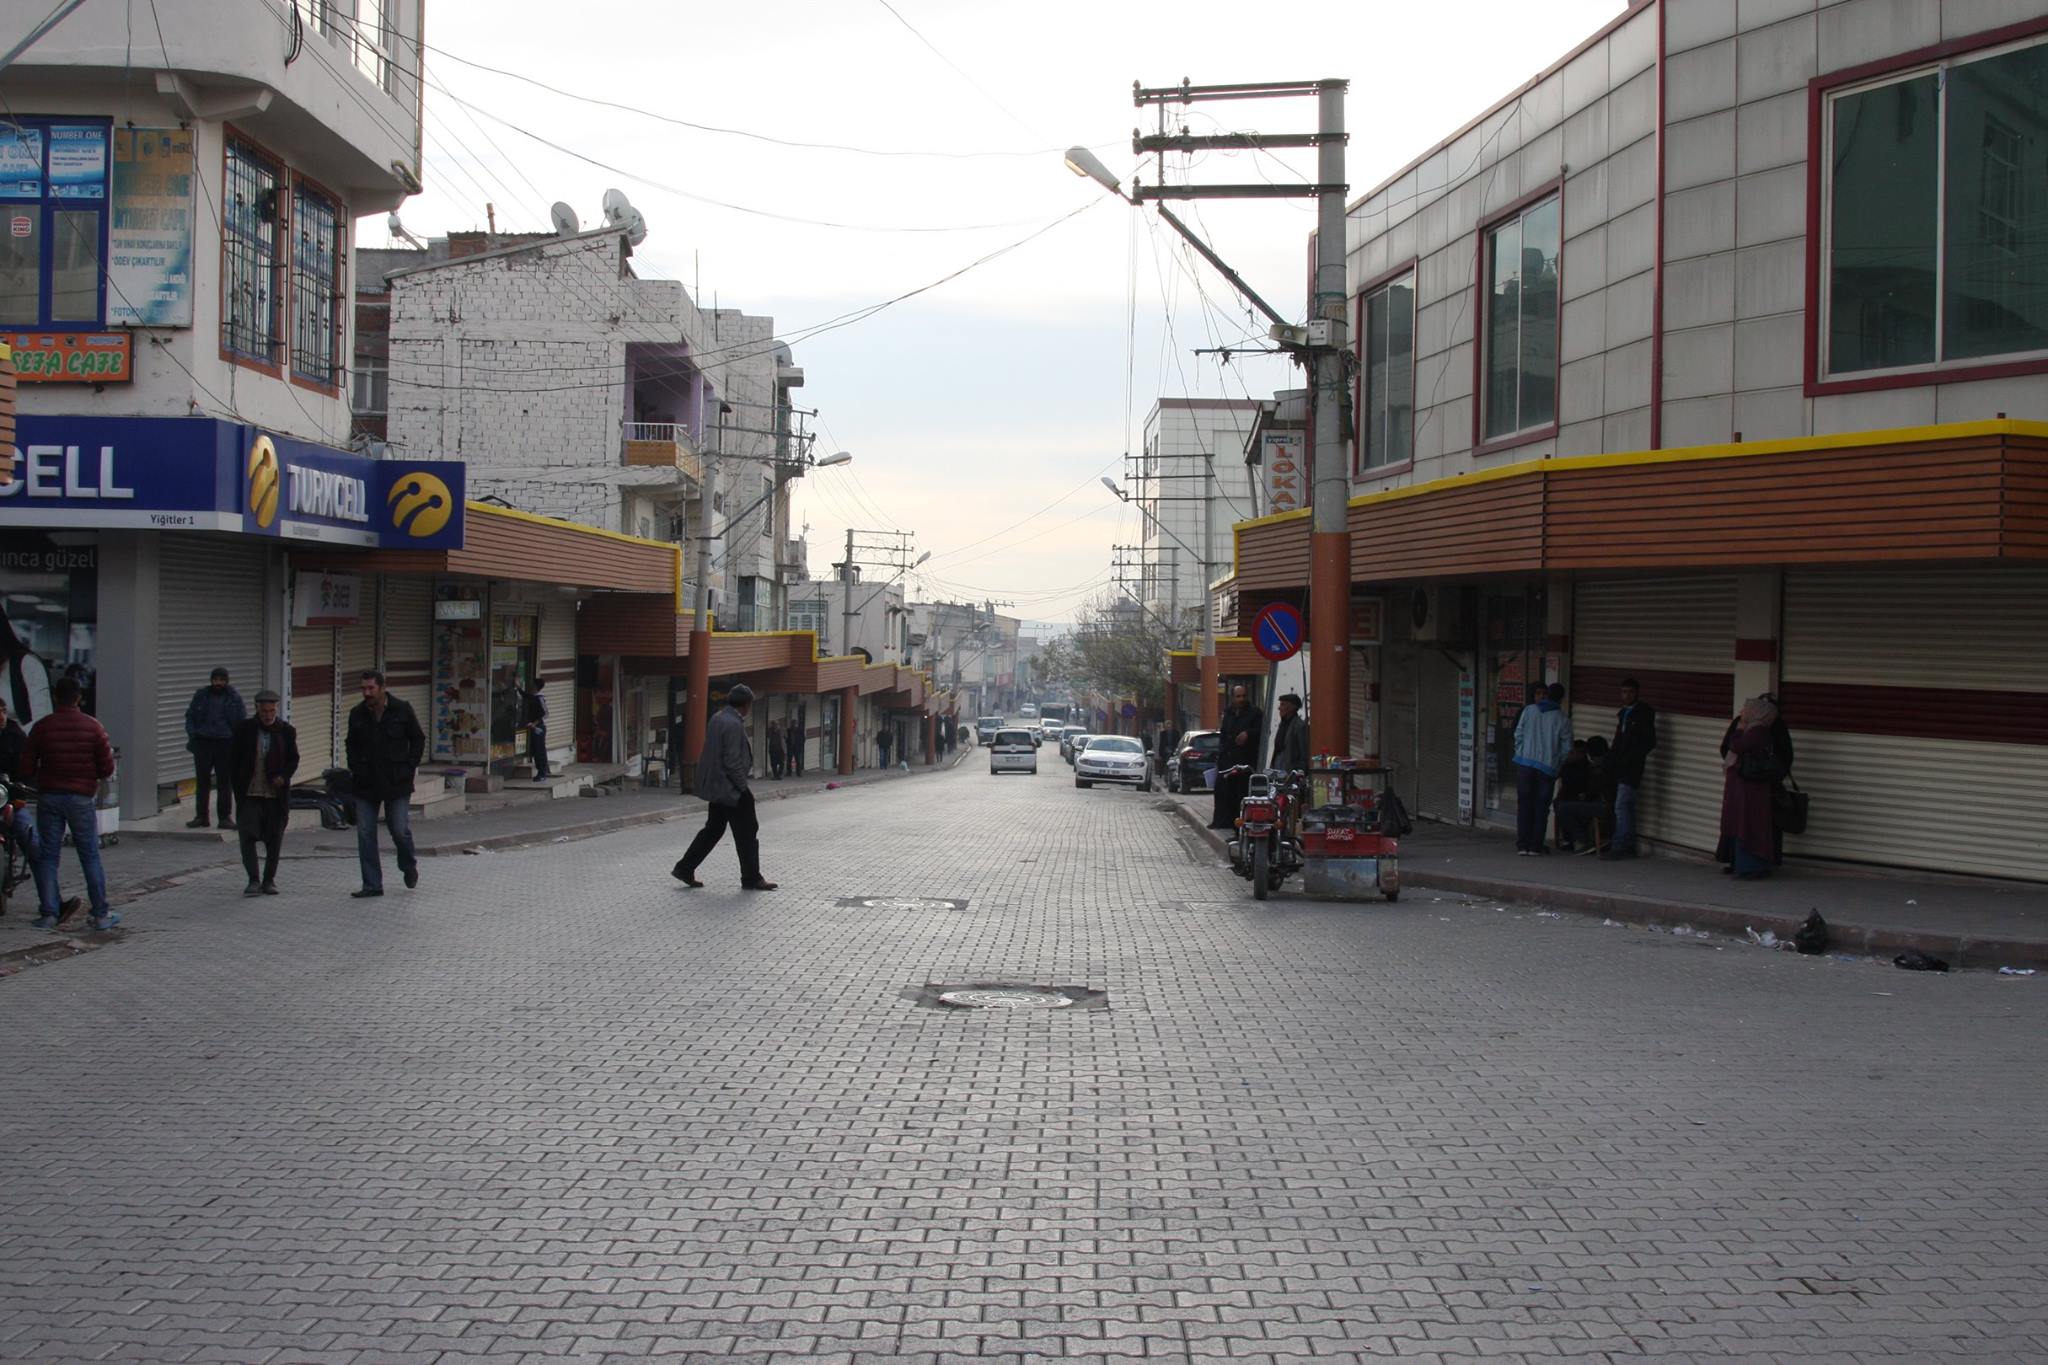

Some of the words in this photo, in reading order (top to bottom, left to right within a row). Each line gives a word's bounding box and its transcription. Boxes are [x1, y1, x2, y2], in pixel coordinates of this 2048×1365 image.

[12, 351, 62, 375] SEFA
[67, 351, 124, 376] CAFE
[286, 464, 369, 523] TURKCELL
[150, 513, 187, 527] Yiğitler
[188, 514, 195, 526] 1
[0, 552, 40, 567] ınca
[45, 548, 95, 572] güzel
